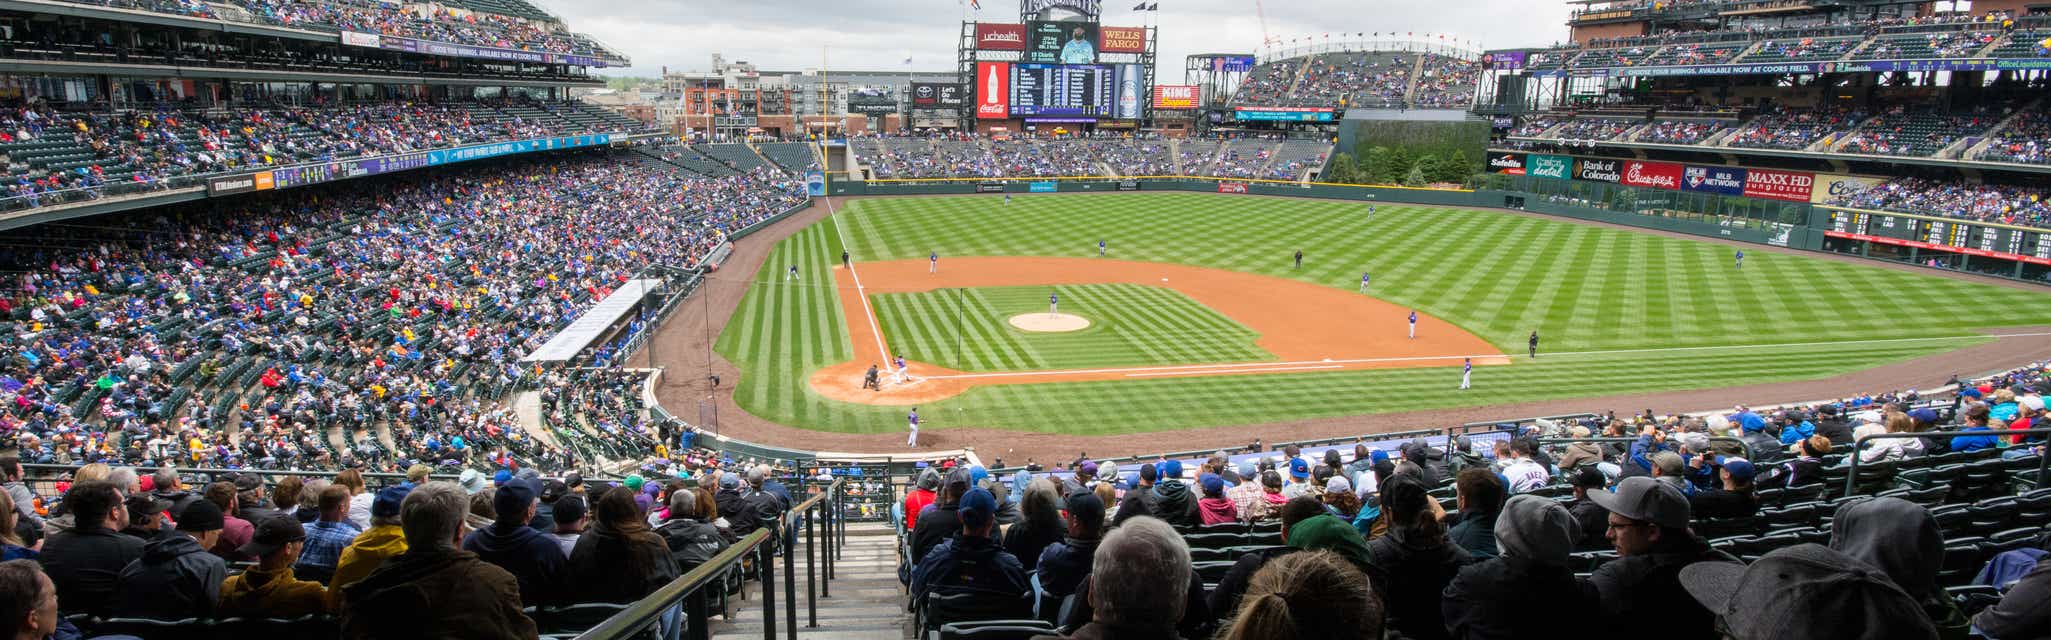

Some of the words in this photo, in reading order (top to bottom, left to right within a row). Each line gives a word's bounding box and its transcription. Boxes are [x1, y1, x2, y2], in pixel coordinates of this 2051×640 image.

[984, 30, 1019, 42] uchealth
[1105, 30, 1141, 40] WELLS
[1105, 39, 1140, 49] FARGO
[1698, 66, 1731, 75] AVAILABLE
[1733, 66, 1752, 74] NOW
[1763, 65, 1788, 73] COORS
[1162, 87, 1192, 98] KING
[980, 104, 1004, 114] Coca-Cola
[1490, 158, 1521, 168] Safelite
[1583, 160, 1604, 171] Bank
[1604, 161, 1615, 171] of
[1533, 164, 1565, 178] dental
[1582, 169, 1620, 181] Colorado
[1715, 172, 1732, 181] MLB
[1704, 177, 1741, 189] NETWORK
[1747, 171, 1789, 186] MAXX
[1790, 175, 1812, 188] HD
[1745, 183, 1810, 194] sunglasses
